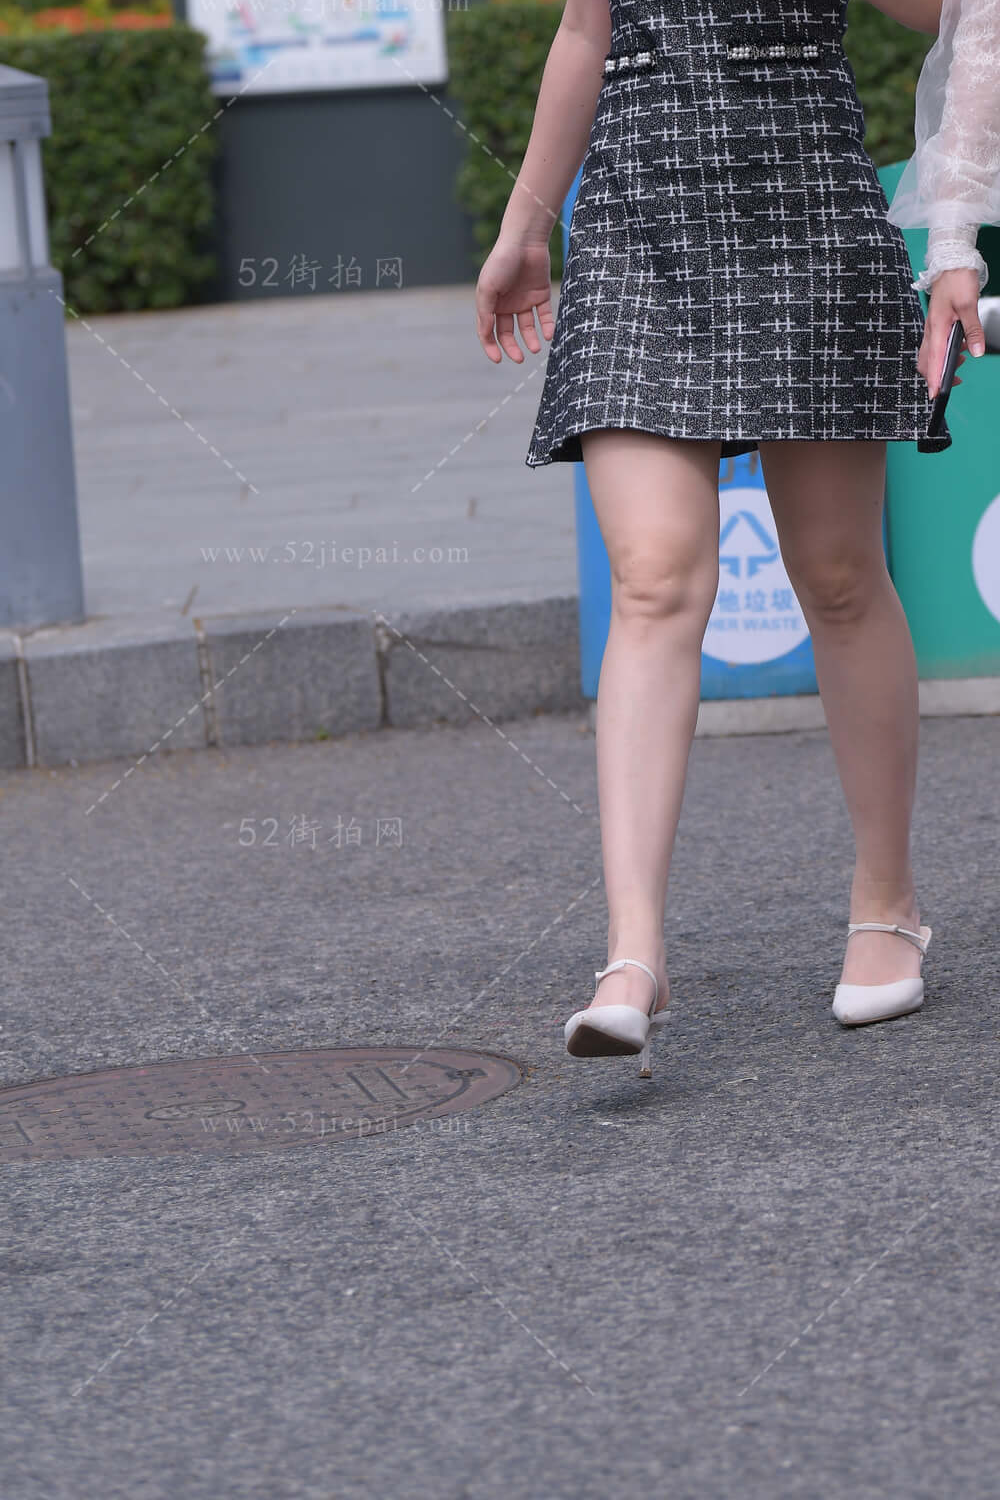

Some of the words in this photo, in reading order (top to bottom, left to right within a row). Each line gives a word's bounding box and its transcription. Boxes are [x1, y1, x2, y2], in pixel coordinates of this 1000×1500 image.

[718, 588, 793, 613] 他垃圾
[743, 617, 801, 631] WASTE
